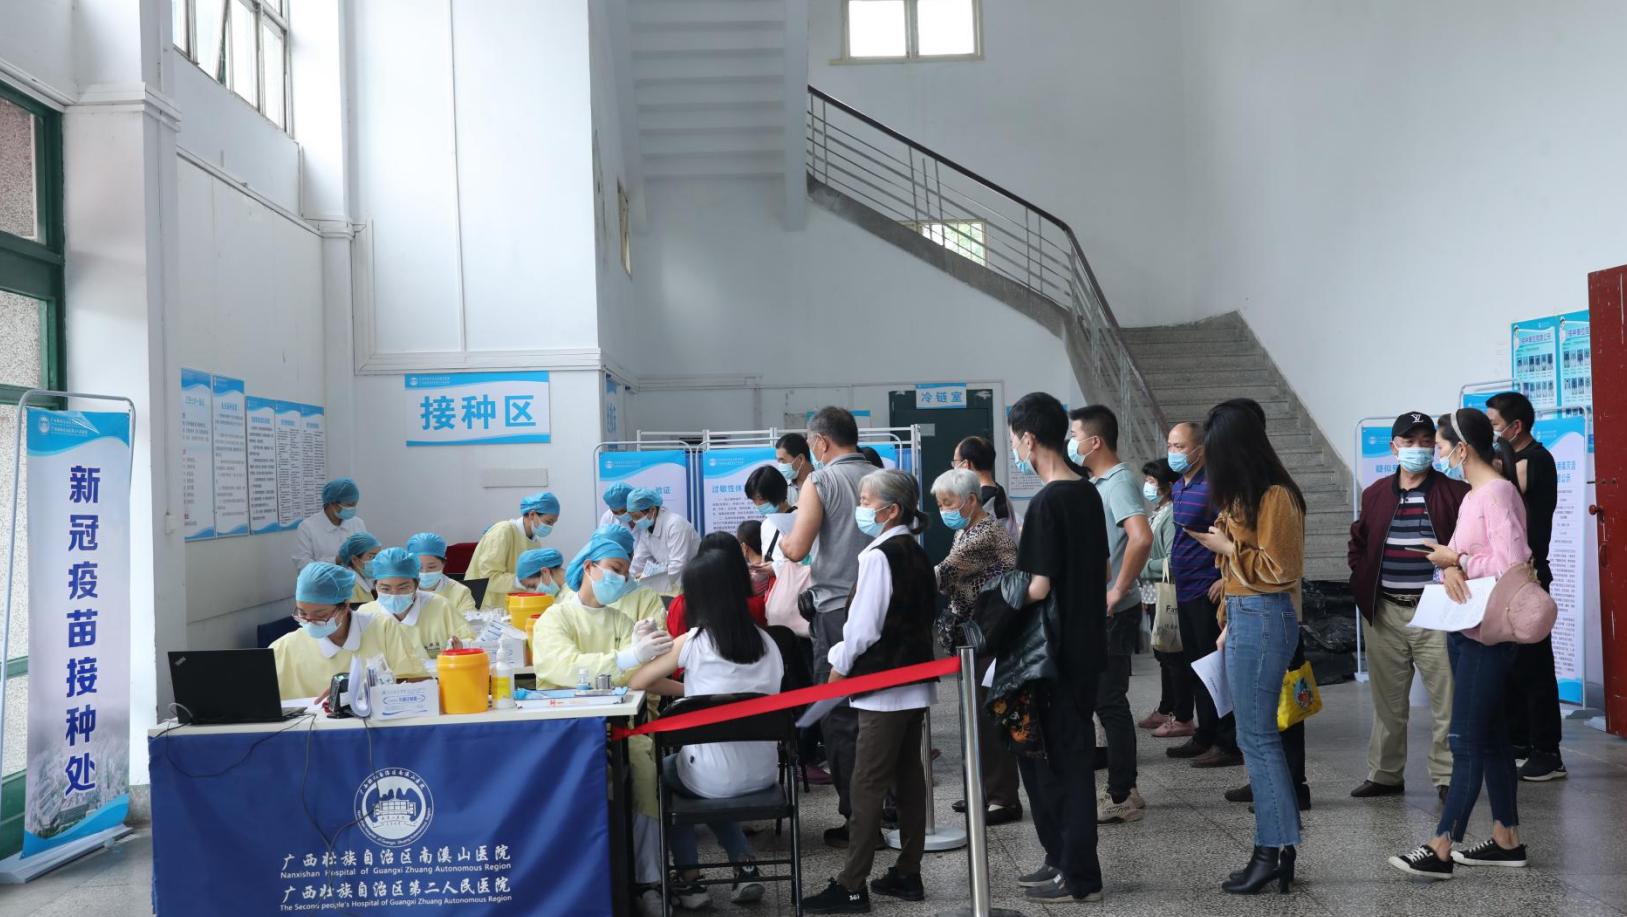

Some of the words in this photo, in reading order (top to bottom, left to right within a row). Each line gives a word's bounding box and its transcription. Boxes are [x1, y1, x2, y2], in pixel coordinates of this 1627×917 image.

[920, 390, 962, 403] 冷链室
[420, 394, 537, 430] 接种区
[64, 464, 101, 796] 新冠疫苗接种处
[280, 871, 321, 879] Nanxishan
[360, 867, 369, 875] of
[373, 867, 403, 875] Guangxi
[405, 866, 433, 874] Zhuang
[435, 865, 483, 873] Autonomous
[484, 863, 512, 871] Region
[281, 844, 511, 871] 广西壮族自治区南溪山医院
[280, 904, 293, 912] The
[351, 899, 380, 908] Hospital
[389, 898, 417, 907] Guangxi
[418, 897, 443, 906] Zhuang
[443, 896, 487, 905] Autonomous
[488, 895, 512, 903] Region
[281, 876, 511, 904] 广西壮族自治区第二人民医院
